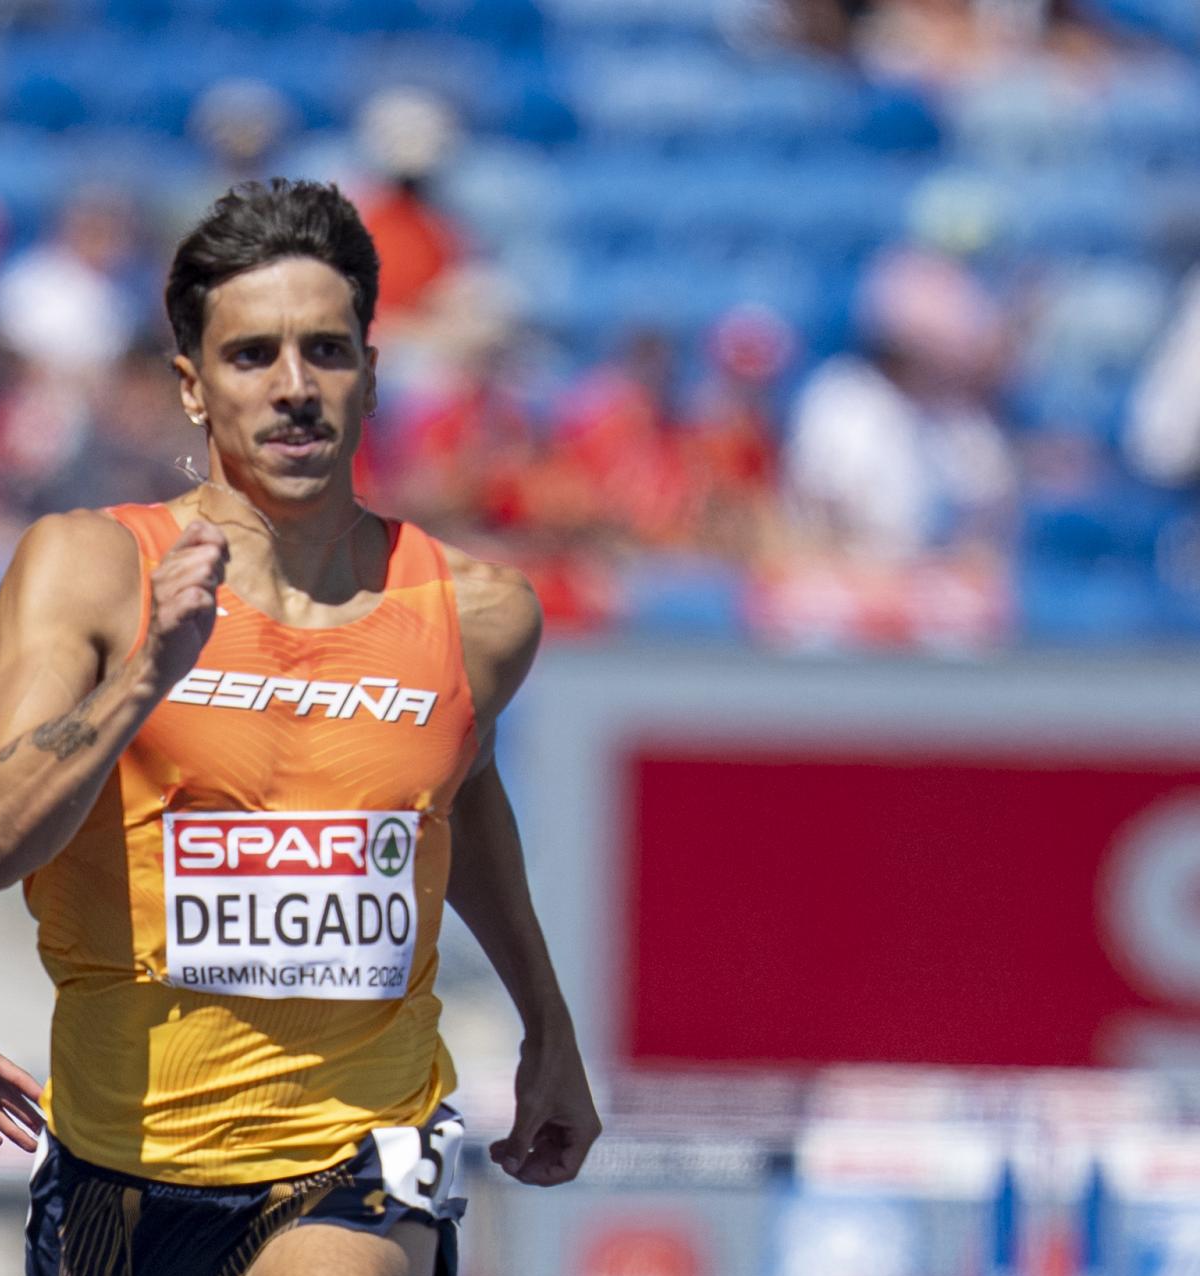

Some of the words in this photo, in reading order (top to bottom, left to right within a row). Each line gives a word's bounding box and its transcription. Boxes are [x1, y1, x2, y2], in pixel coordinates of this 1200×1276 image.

[166, 668, 438, 726] ESPAÑA
[179, 826, 365, 869] SPAR
[175, 893, 410, 946] DELGADO
[183, 966, 360, 987] BIRMINGHAM
[416, 1125, 445, 1201] 5
